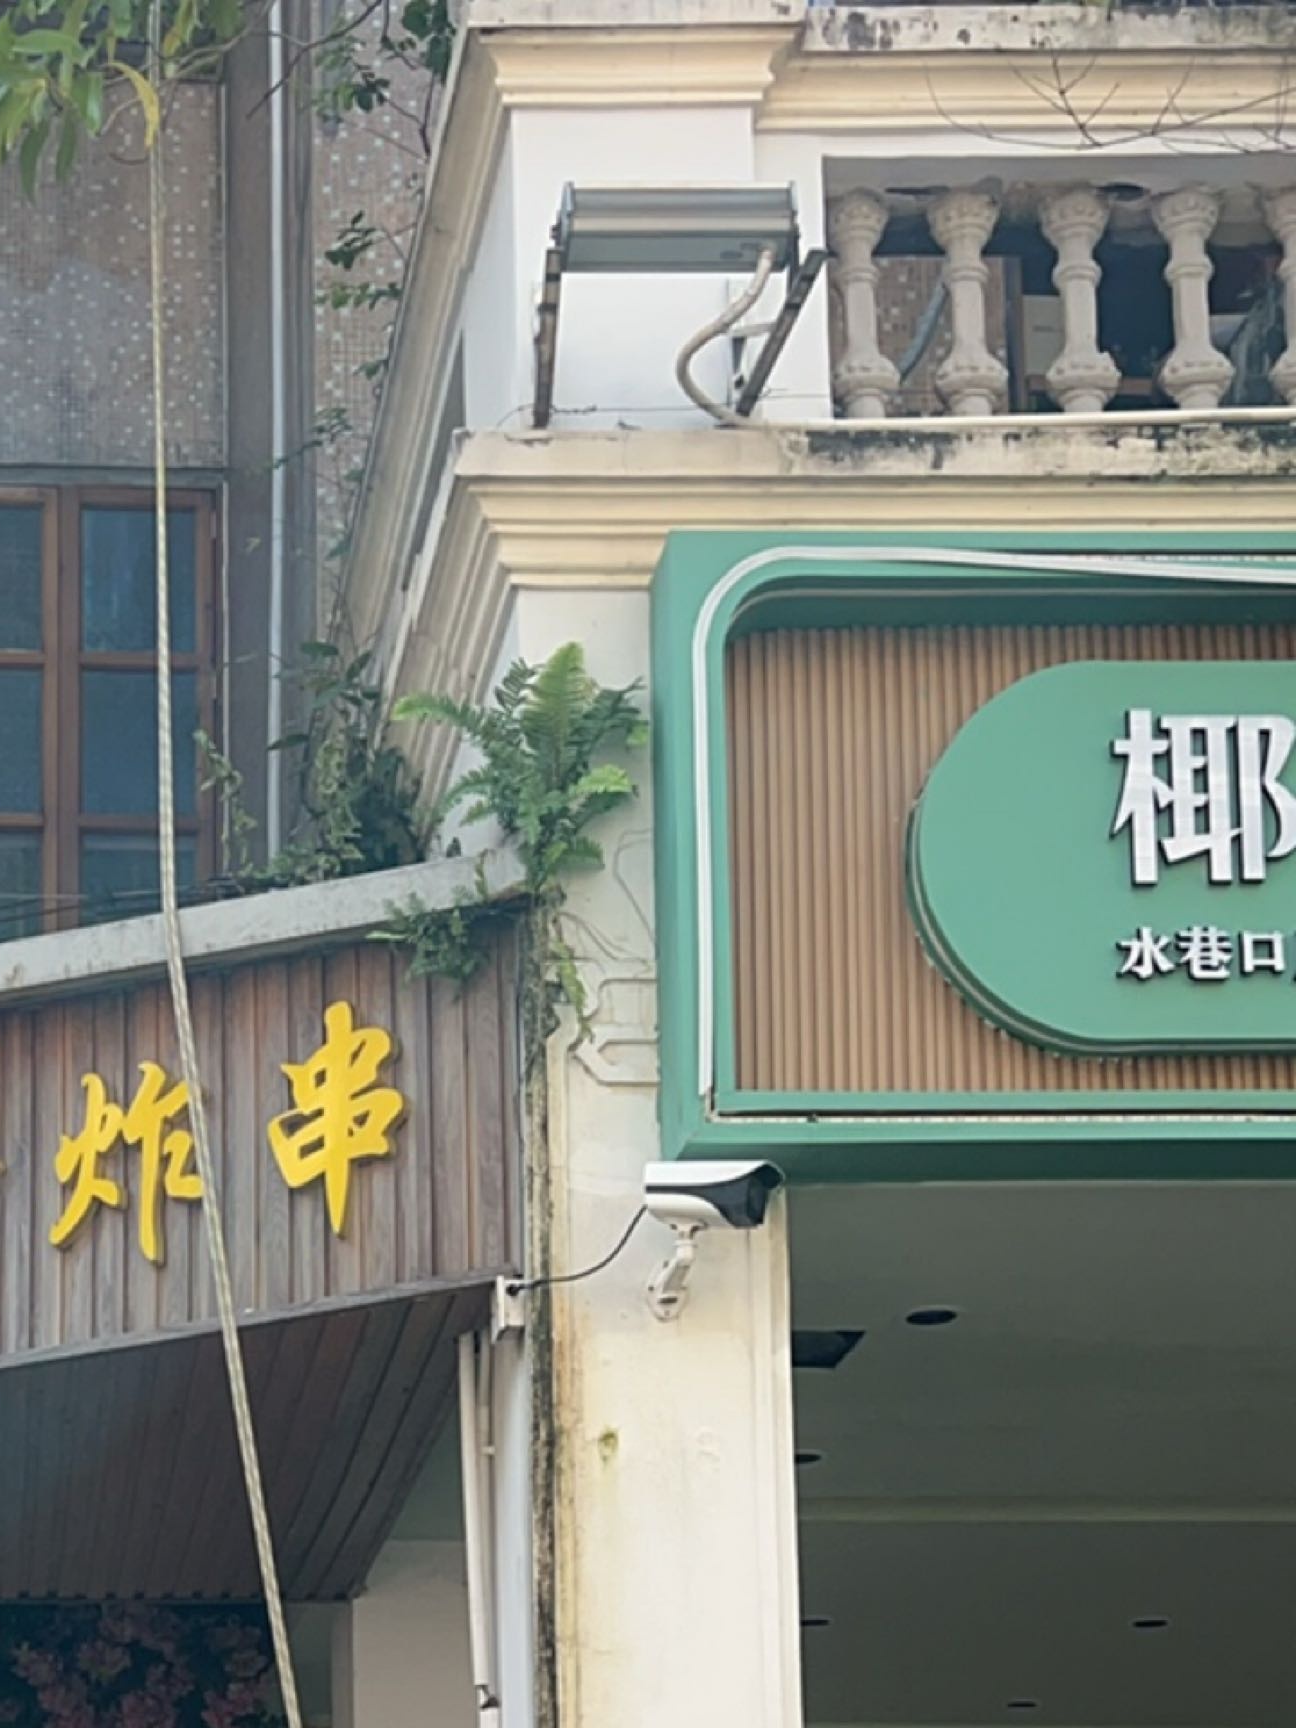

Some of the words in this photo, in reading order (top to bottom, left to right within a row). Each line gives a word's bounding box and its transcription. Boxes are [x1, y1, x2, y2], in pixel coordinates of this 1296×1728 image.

[1113, 707, 1296, 885] 椰
[1119, 925, 1286, 980] 水巷口
